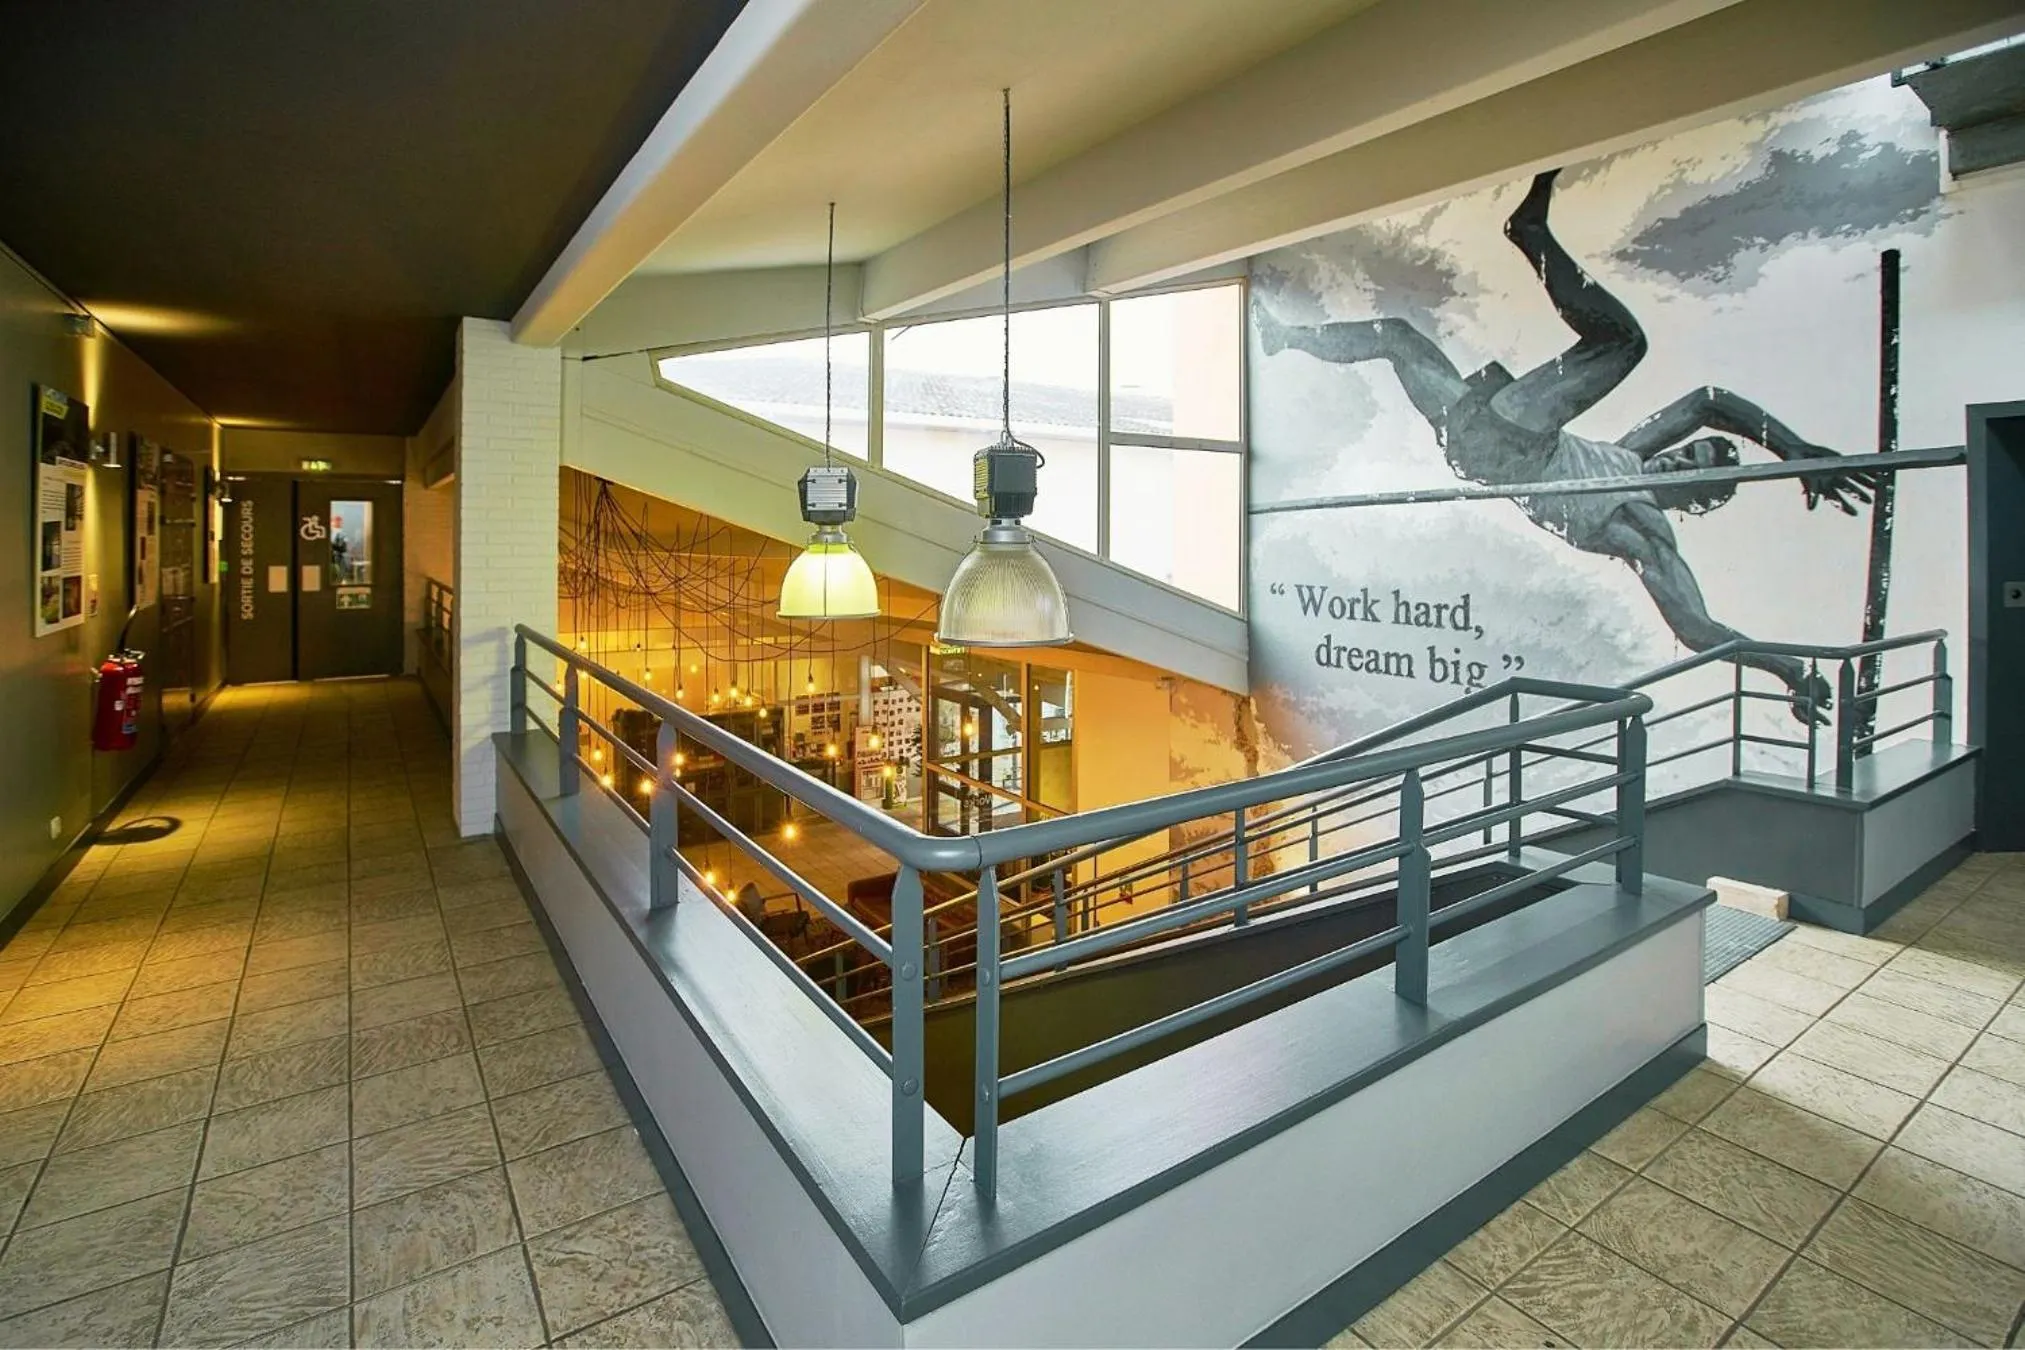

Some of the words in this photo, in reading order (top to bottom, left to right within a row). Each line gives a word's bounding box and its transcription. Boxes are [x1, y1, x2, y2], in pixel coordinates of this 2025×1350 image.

[240, 499, 254, 555] SECOURS
[240, 558, 254, 575] DE
[240, 577, 254, 620] SORTIE
[1391, 588, 1484, 640] hard,
[1315, 633, 1415, 679] dream
